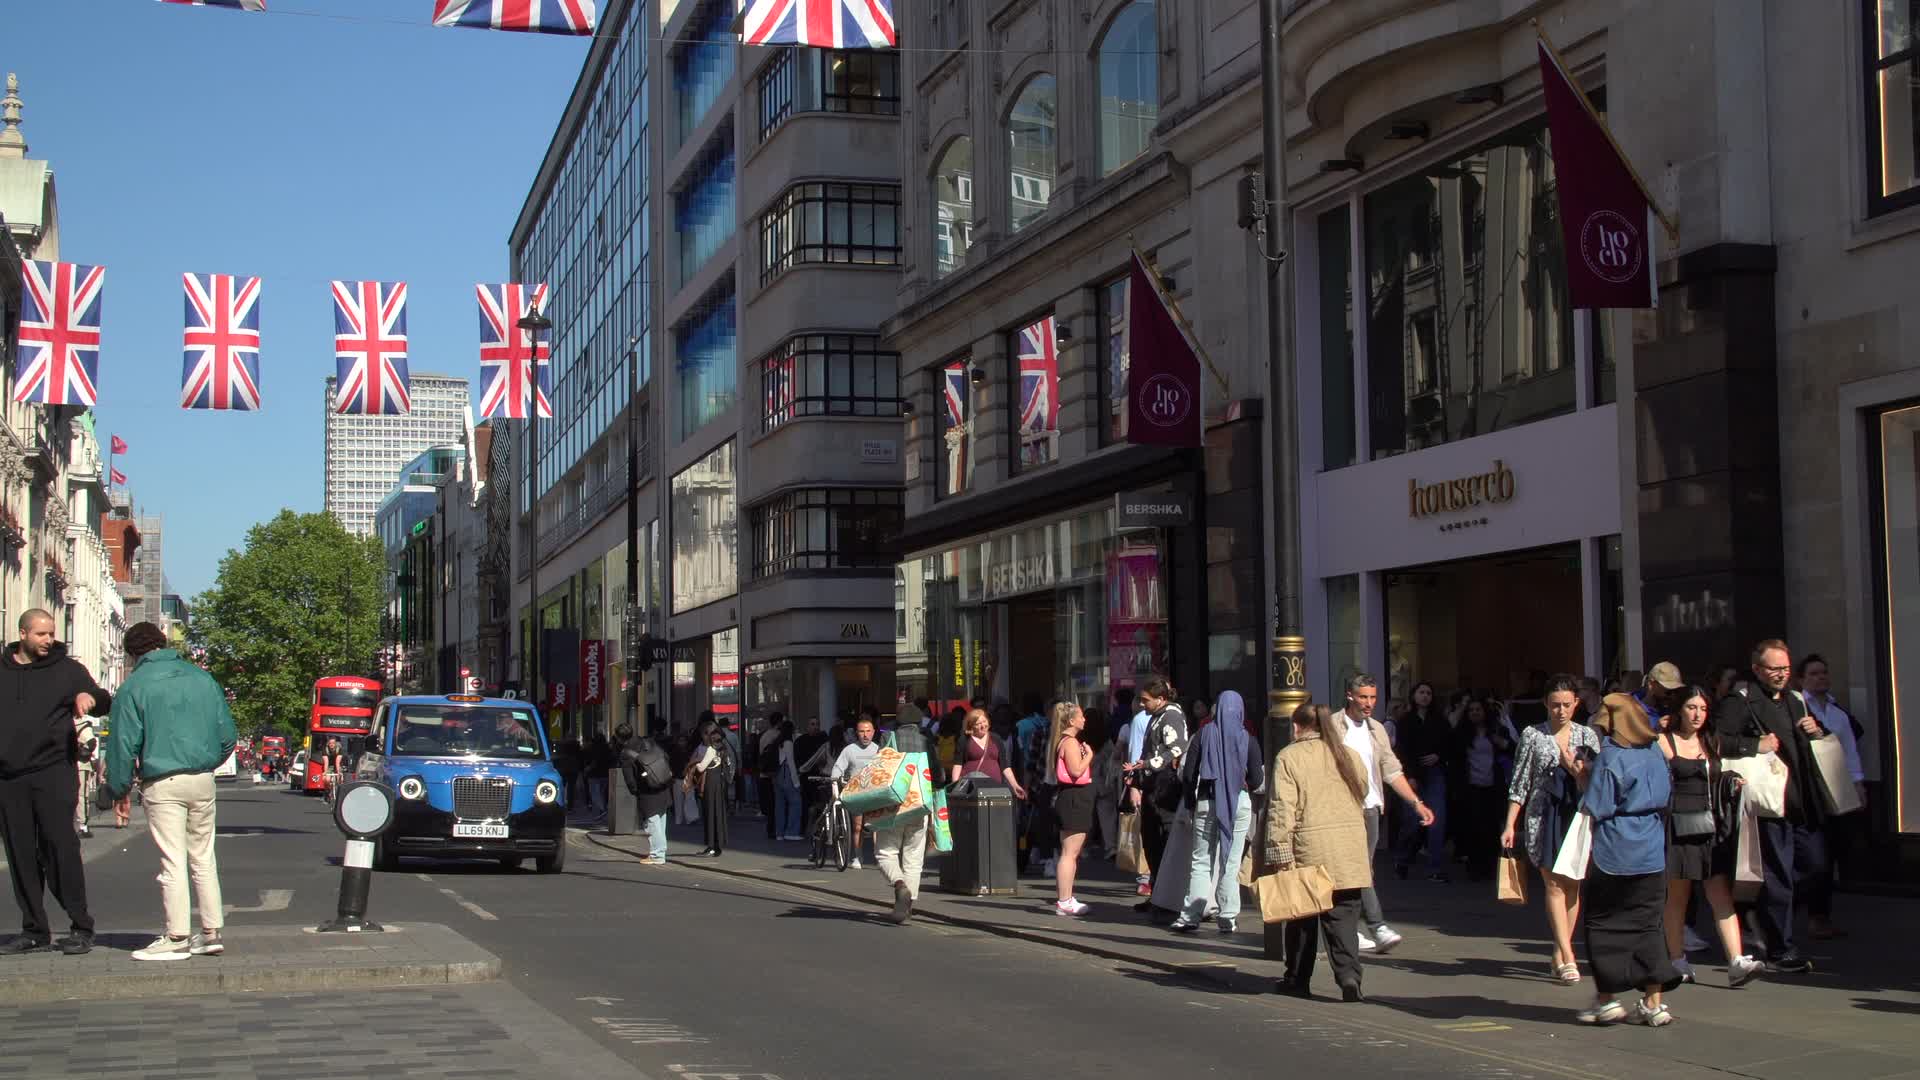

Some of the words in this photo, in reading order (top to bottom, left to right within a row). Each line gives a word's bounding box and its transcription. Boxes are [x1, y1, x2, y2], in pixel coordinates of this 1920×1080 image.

[1126, 504, 1182, 514] BERSHKA
[992, 554, 1055, 594] BERSHKA
[457, 826, 483, 835] LL69
[485, 826, 505, 836] KNJ
